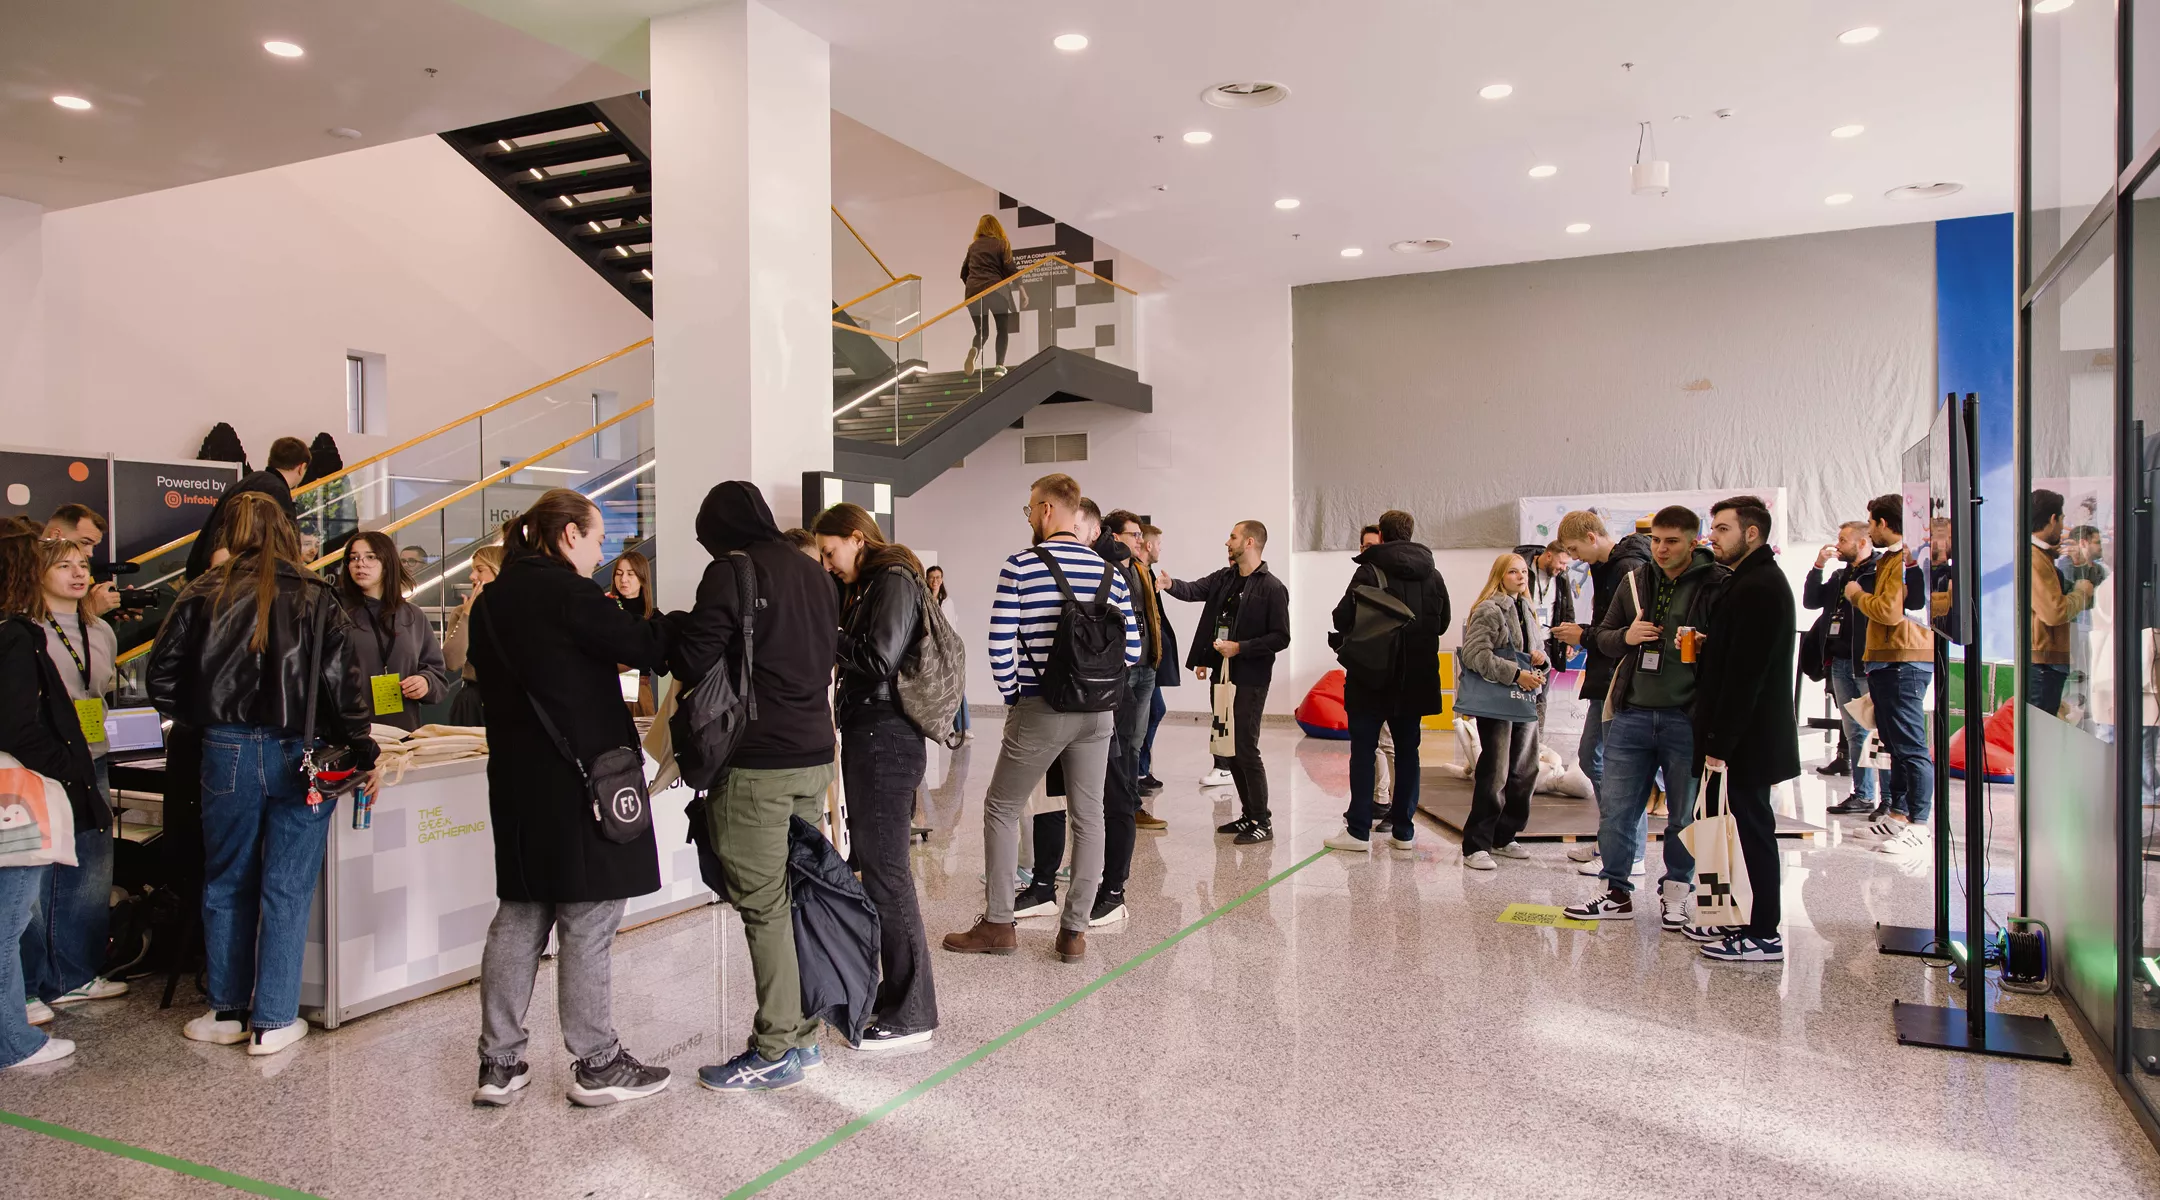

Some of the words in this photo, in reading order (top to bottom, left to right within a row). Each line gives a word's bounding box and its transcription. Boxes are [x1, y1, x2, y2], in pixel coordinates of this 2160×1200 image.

[156, 475, 210, 490] Powered
[212, 478, 227, 493] by
[418, 805, 443, 819] THE
[620, 795, 635, 815] FC
[418, 816, 453, 832] GEEK
[418, 820, 486, 844] GATHERING
